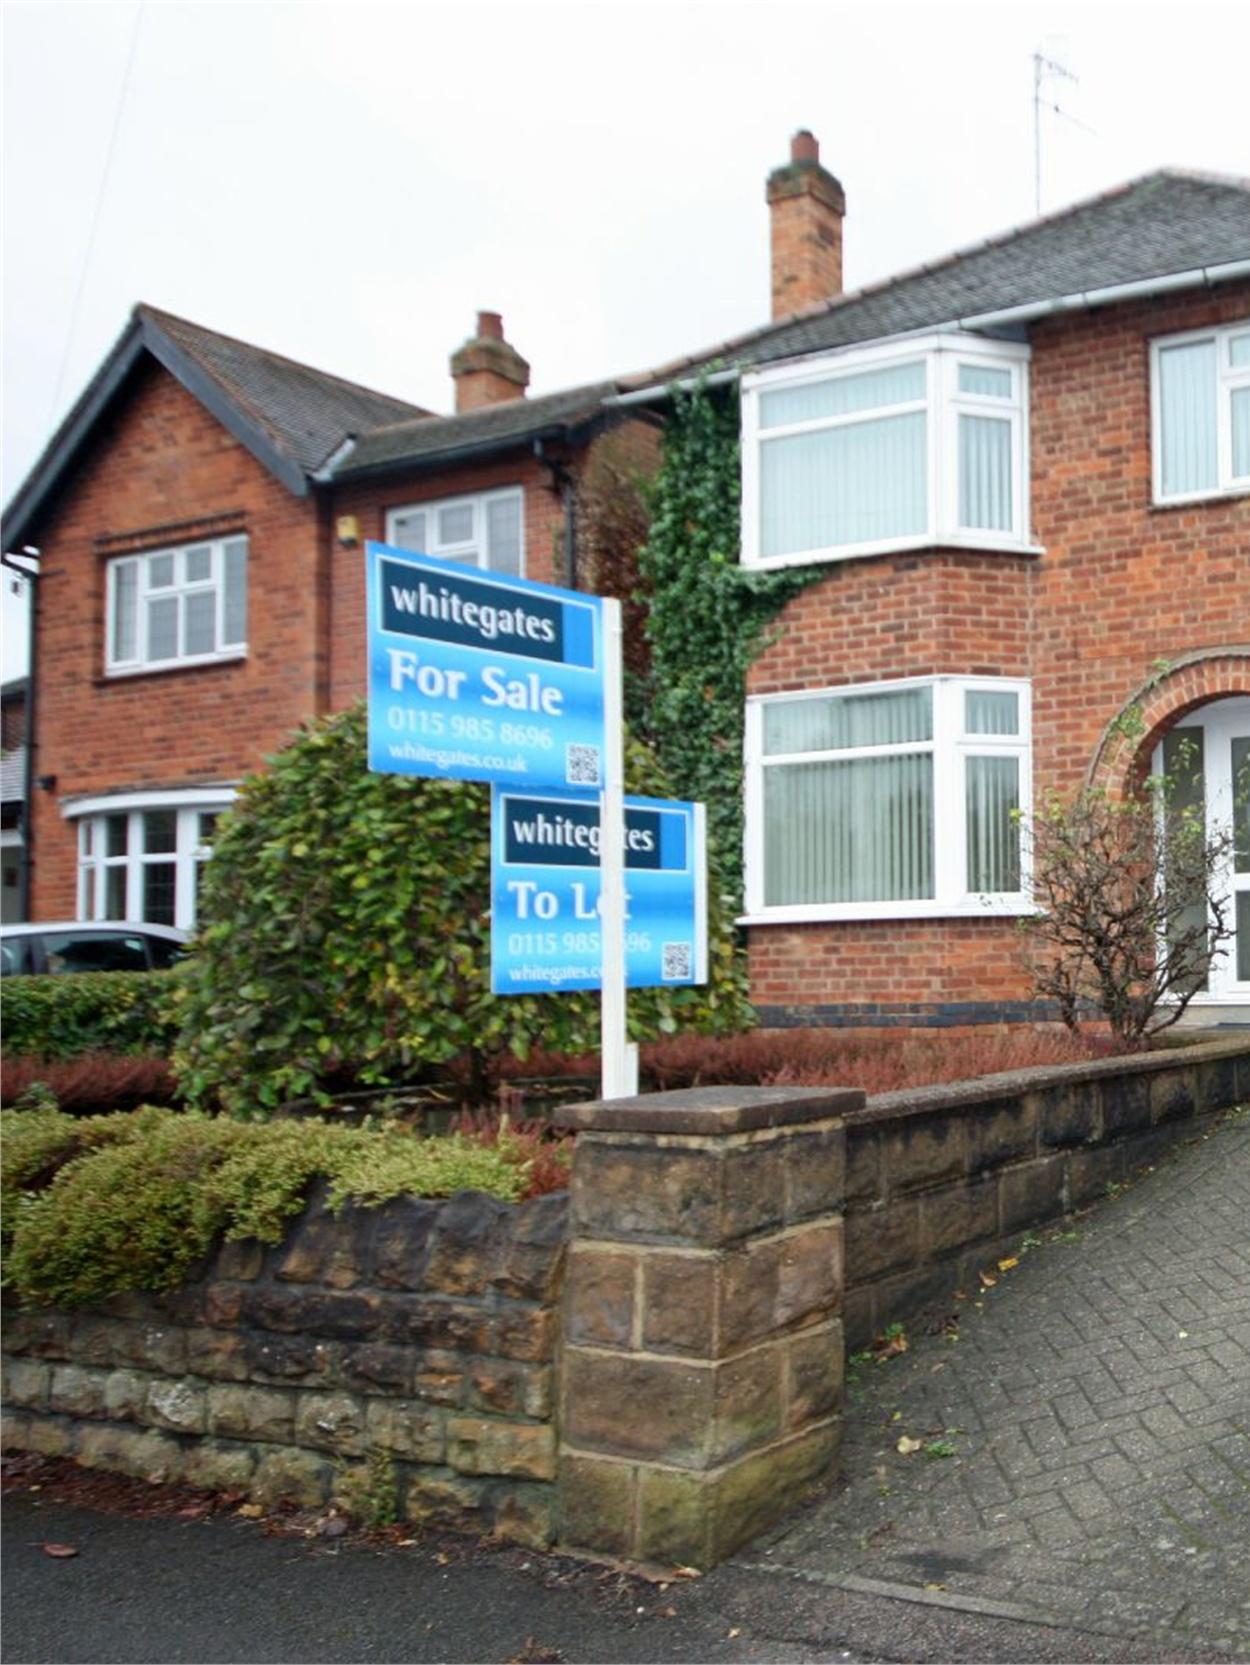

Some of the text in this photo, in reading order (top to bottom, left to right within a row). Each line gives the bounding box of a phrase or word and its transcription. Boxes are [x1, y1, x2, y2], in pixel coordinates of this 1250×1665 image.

[390, 582, 555, 642] whitegates
[386, 648, 563, 716] For Sale
[387, 705, 555, 750] 0115 985 8696
[388, 739, 528, 771] whitegates.co.uk
[513, 813, 654, 855] whiteges
[507, 881, 559, 919] To
[508, 932, 557, 955] 0115
[562, 931, 602, 954] 985
